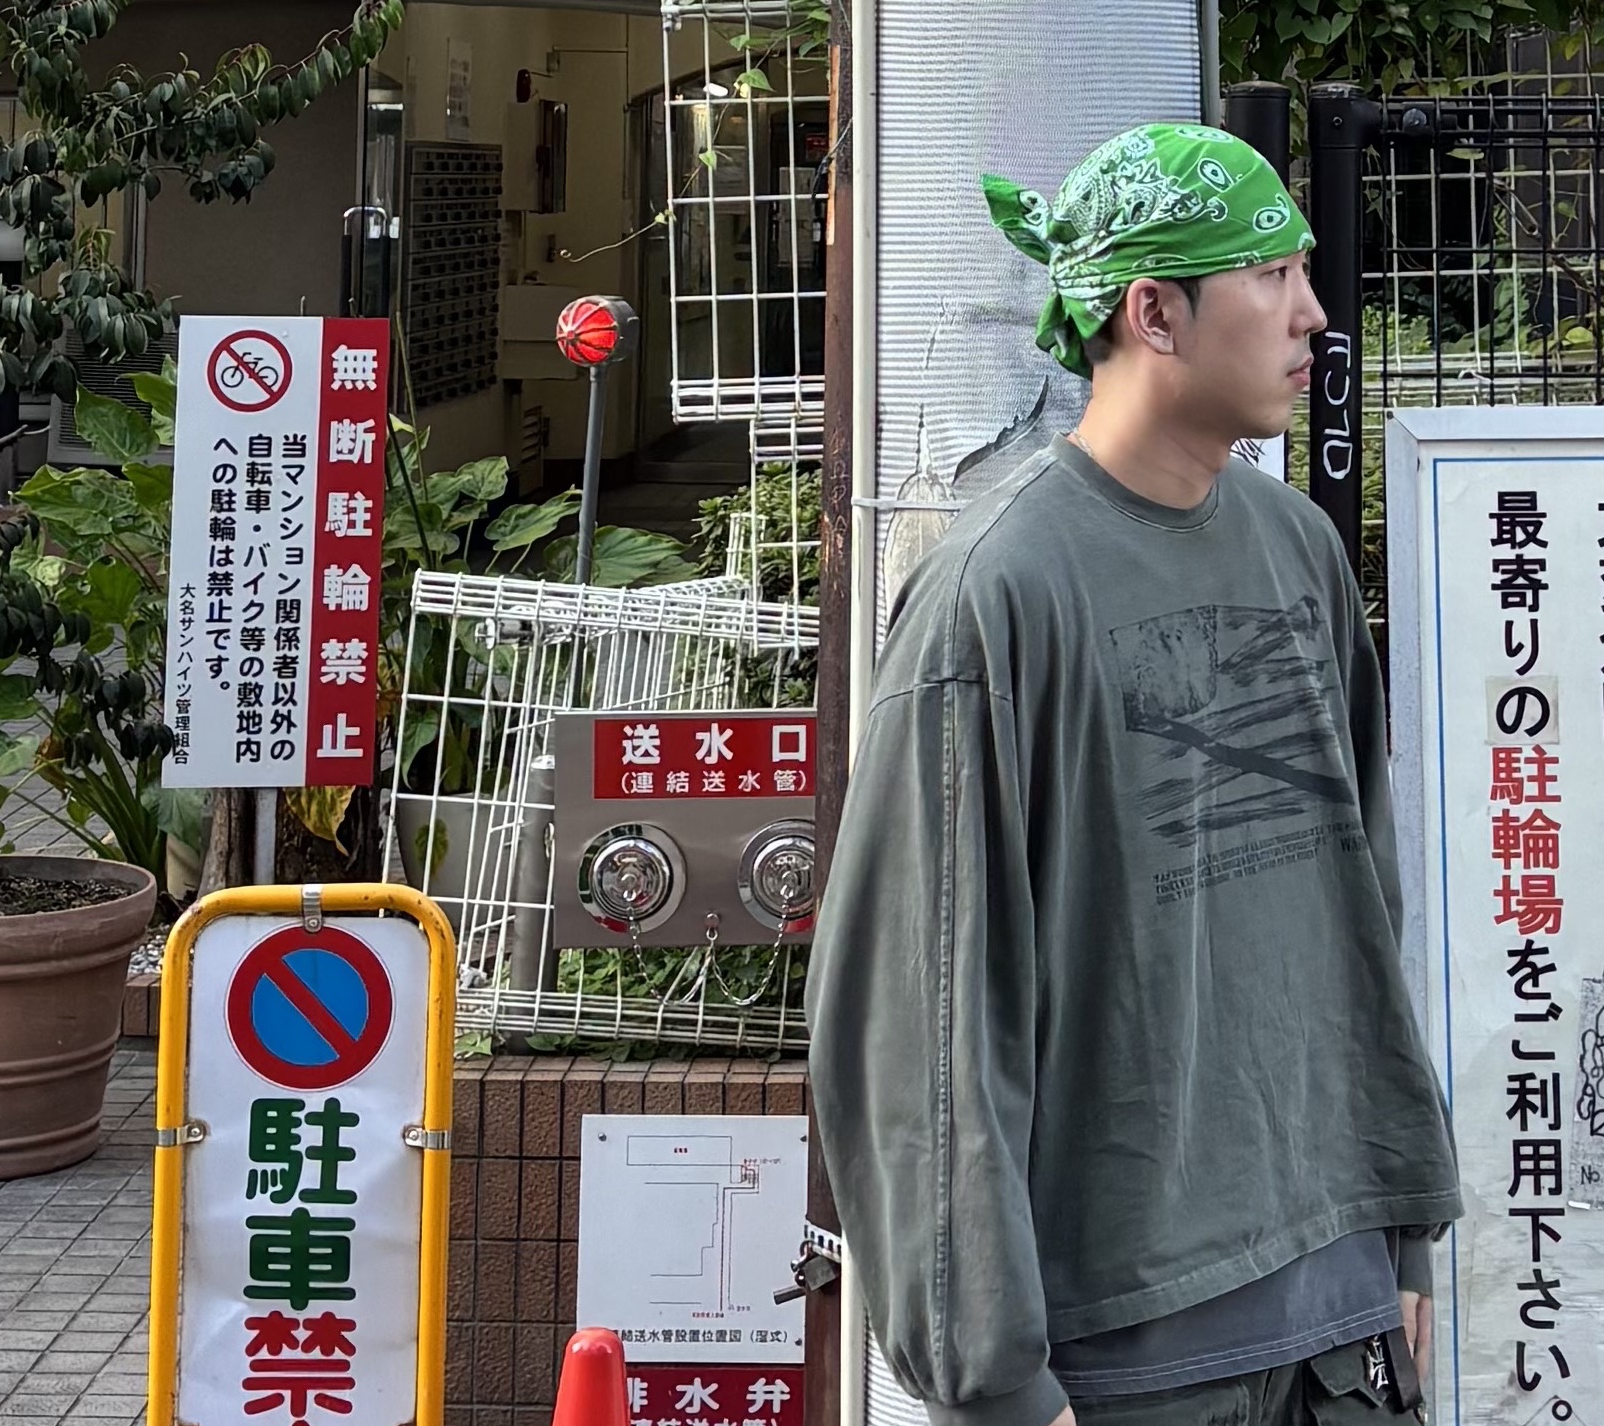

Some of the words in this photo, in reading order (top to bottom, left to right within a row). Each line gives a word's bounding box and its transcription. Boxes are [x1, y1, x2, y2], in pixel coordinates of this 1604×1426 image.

[173, 582, 197, 765] 大名サンハイツ管理組合
[204, 436, 239, 692] への駐輪は禁止です。
[235, 433, 274, 764] 自転車・バイク等の敷地内
[269, 432, 308, 762] 当マンション関係者以外の
[315, 343, 379, 760] 無断駐輪禁止
[621, 722, 808, 765] 送水口
[1487, 489, 1573, 1422] 最寄りの駐輪場をご利用下さい。
